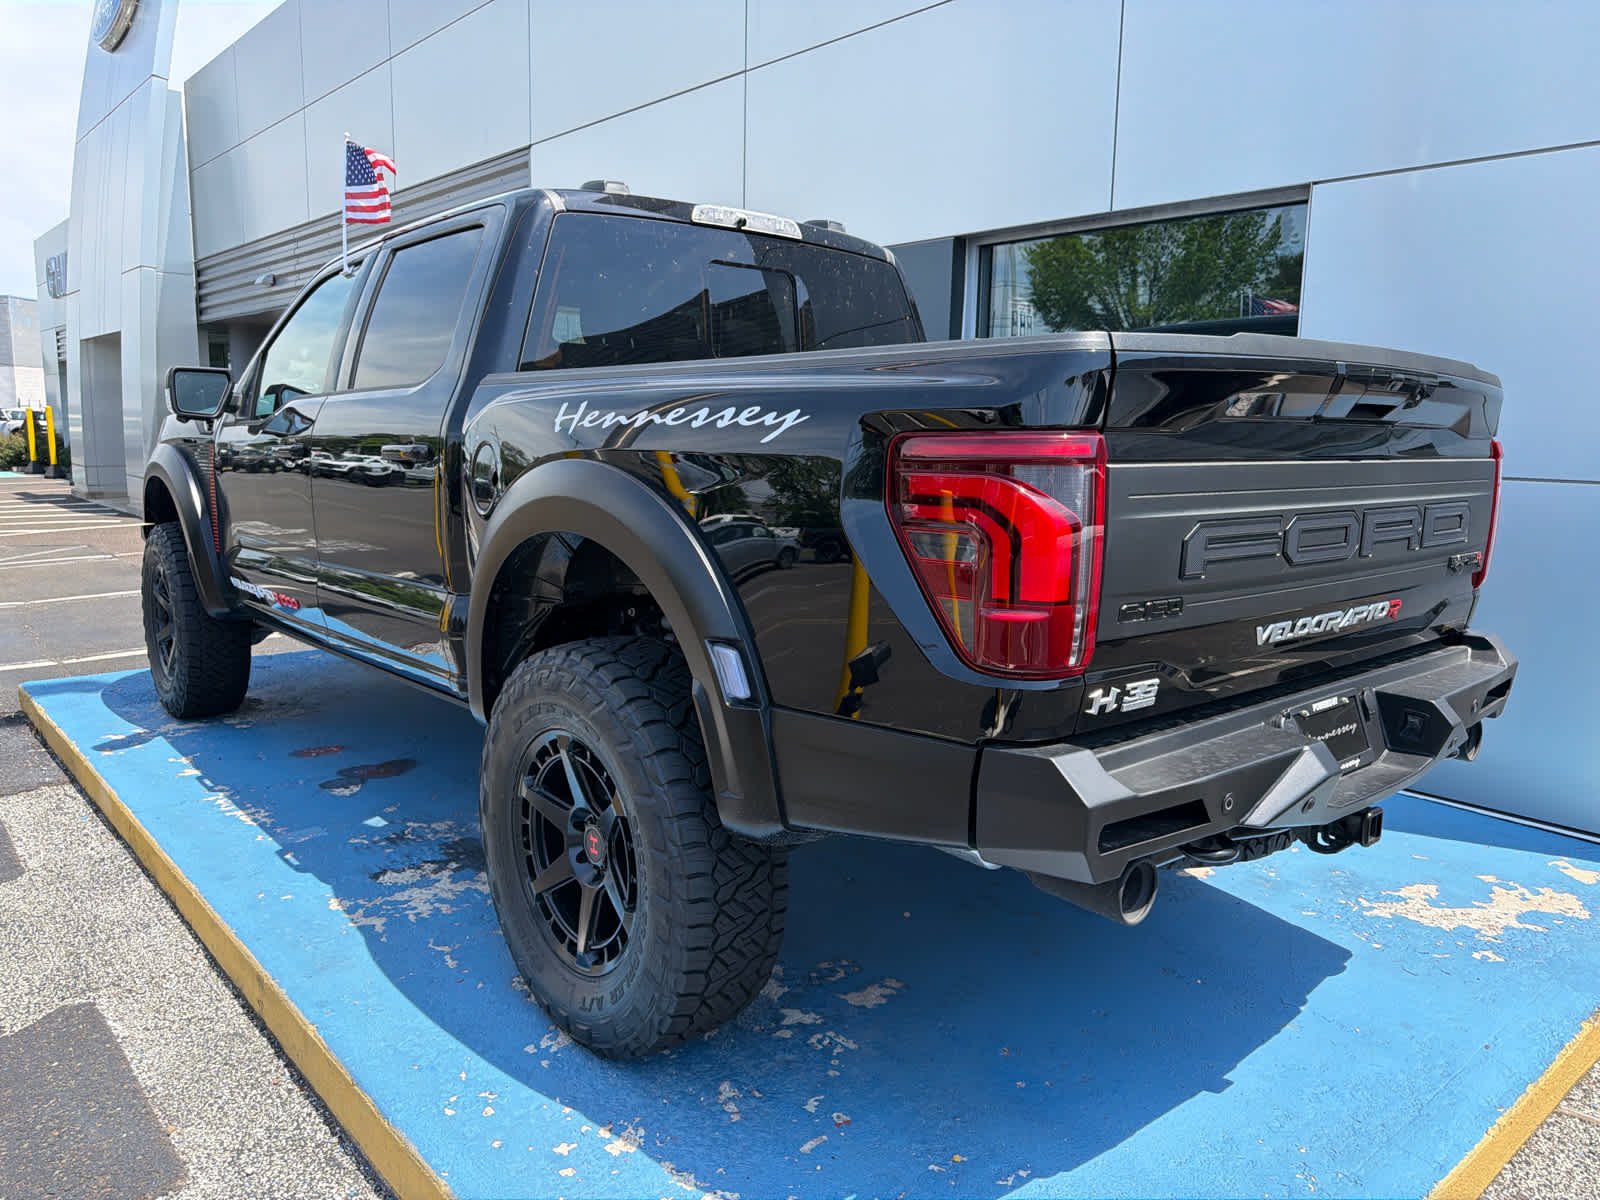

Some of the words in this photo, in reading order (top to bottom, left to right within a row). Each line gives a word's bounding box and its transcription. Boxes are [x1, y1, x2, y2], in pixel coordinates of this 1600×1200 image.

[554, 400, 810, 443] Hennessey
[1179, 501, 1472, 580] FORD
[1307, 723, 1358, 741] nnessey
